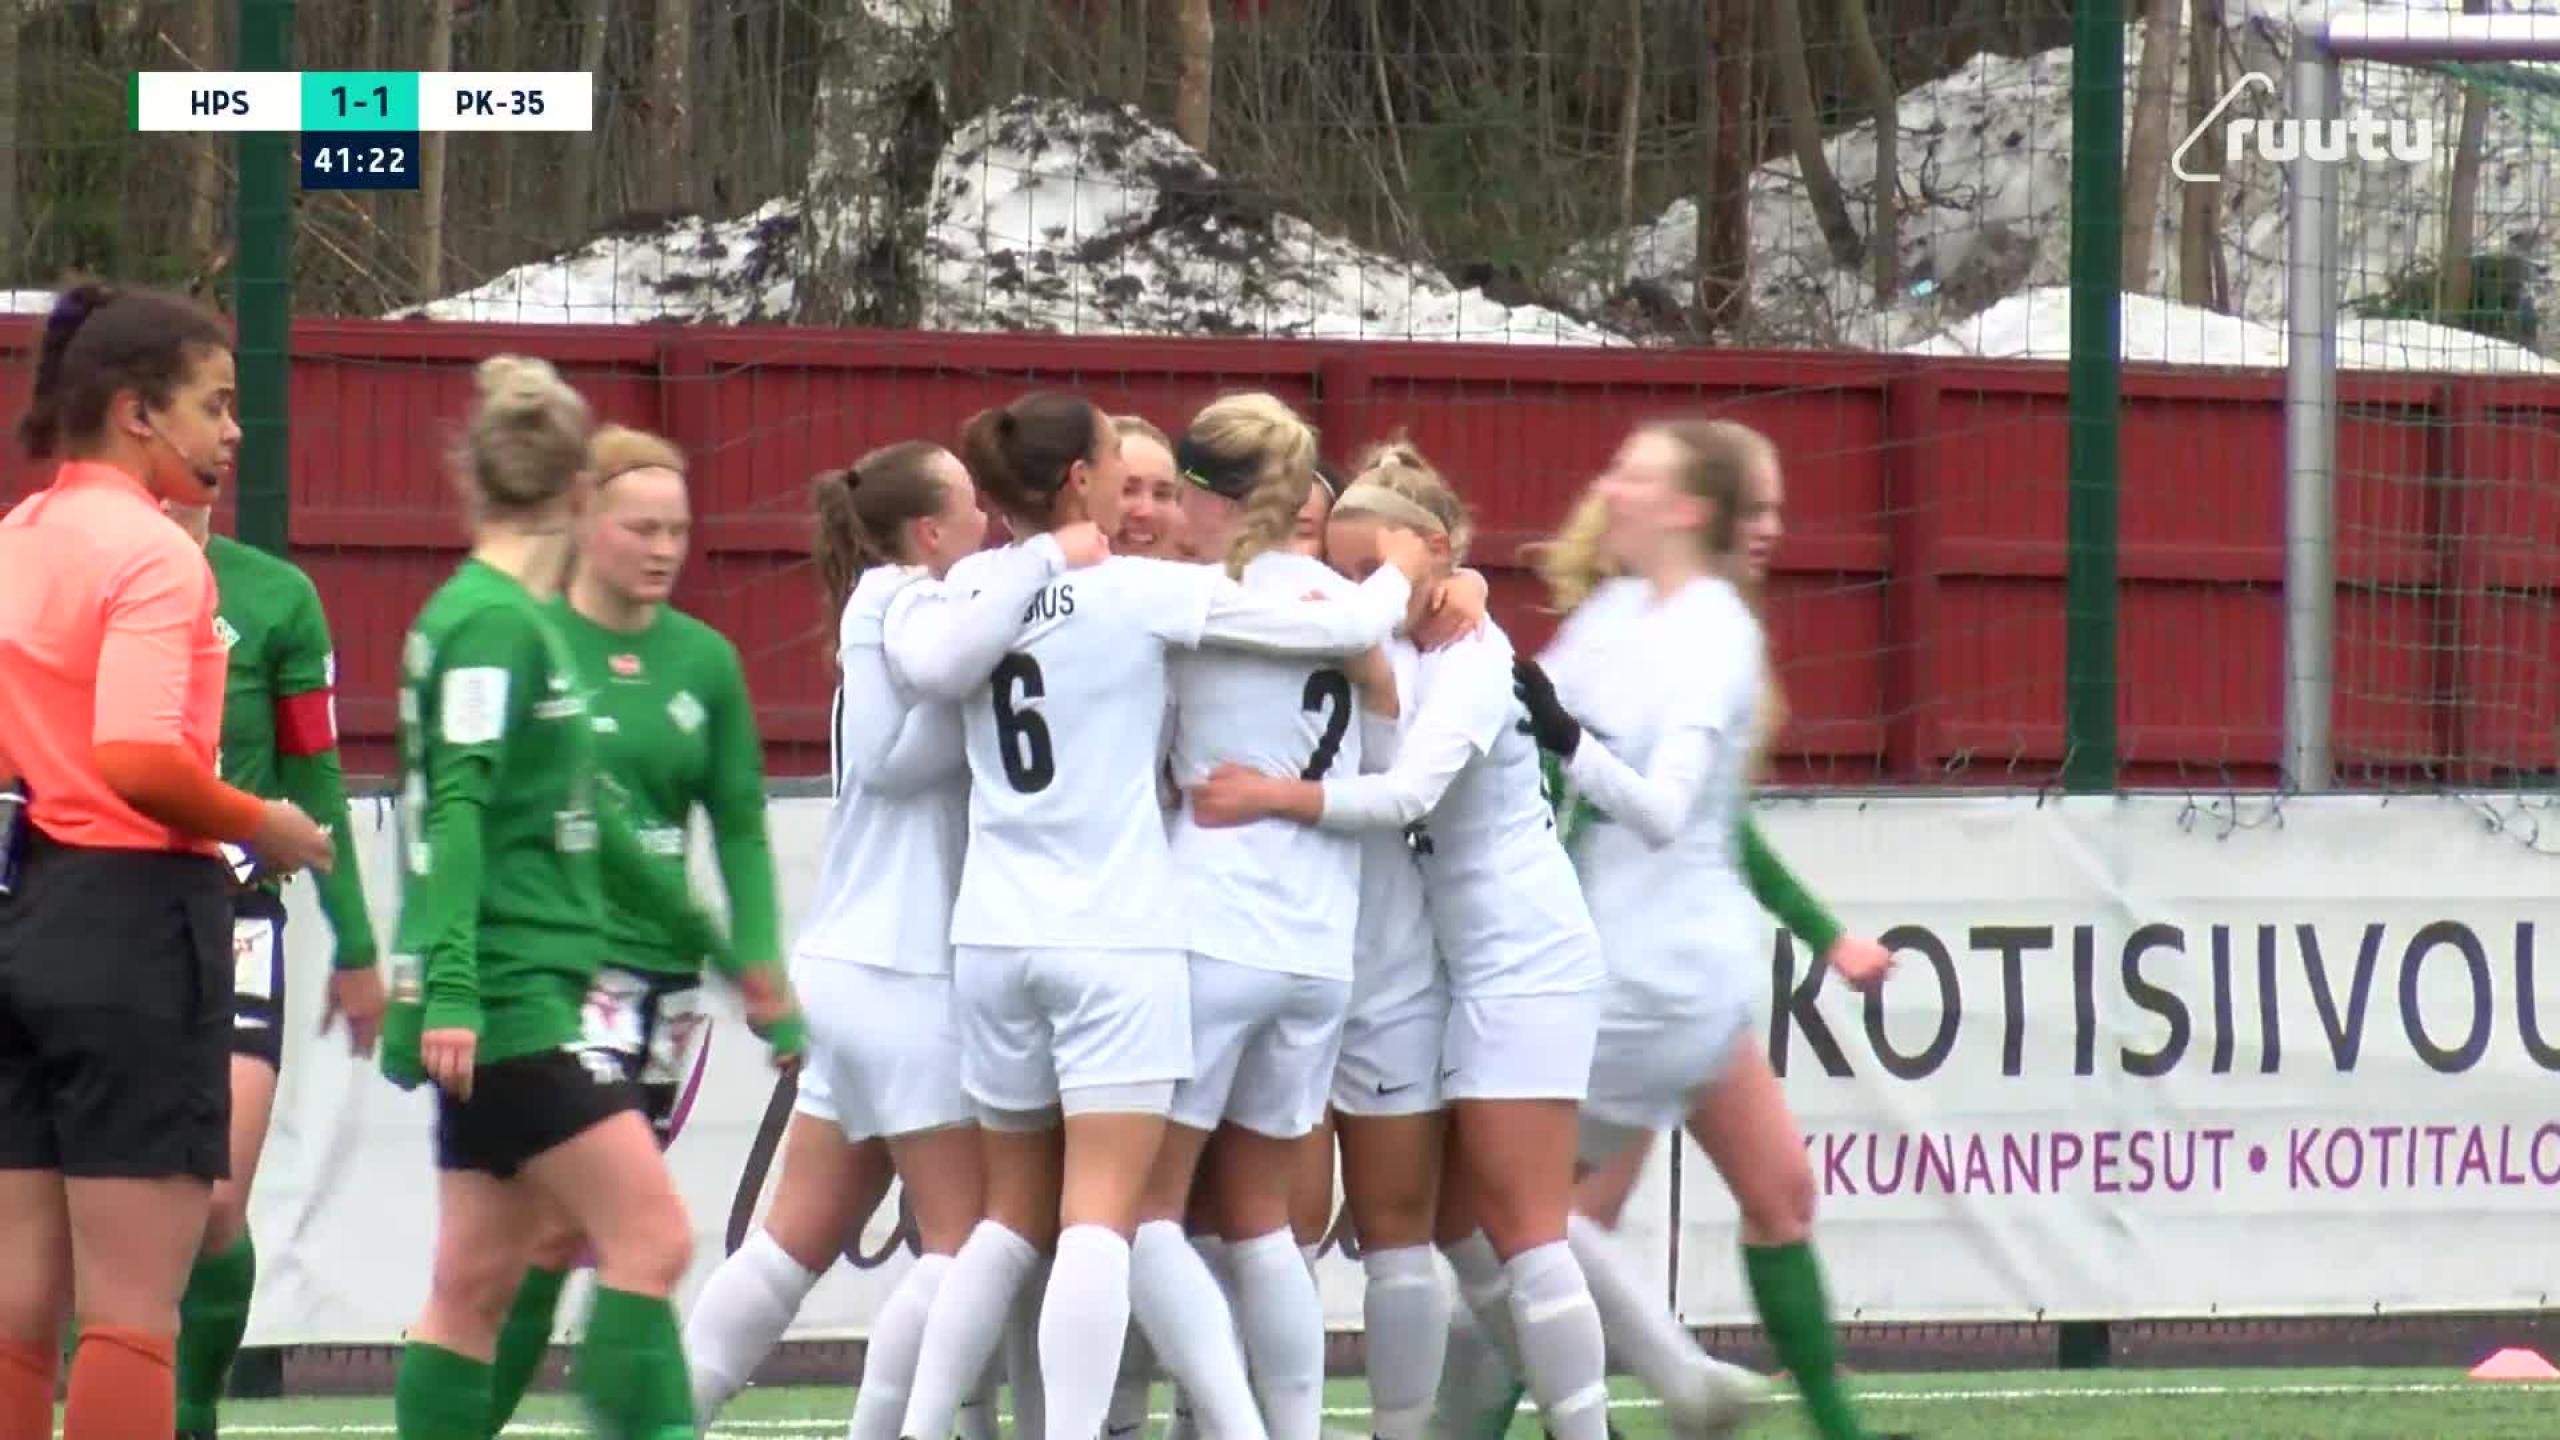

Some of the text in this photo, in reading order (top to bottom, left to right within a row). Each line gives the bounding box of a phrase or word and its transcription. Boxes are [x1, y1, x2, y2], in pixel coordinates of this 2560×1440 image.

[991, 652, 1055, 795] 6
[1302, 668, 1352, 781] 2
[1804, 1123, 2560, 1195] KUNANPESUT KOTITALO
